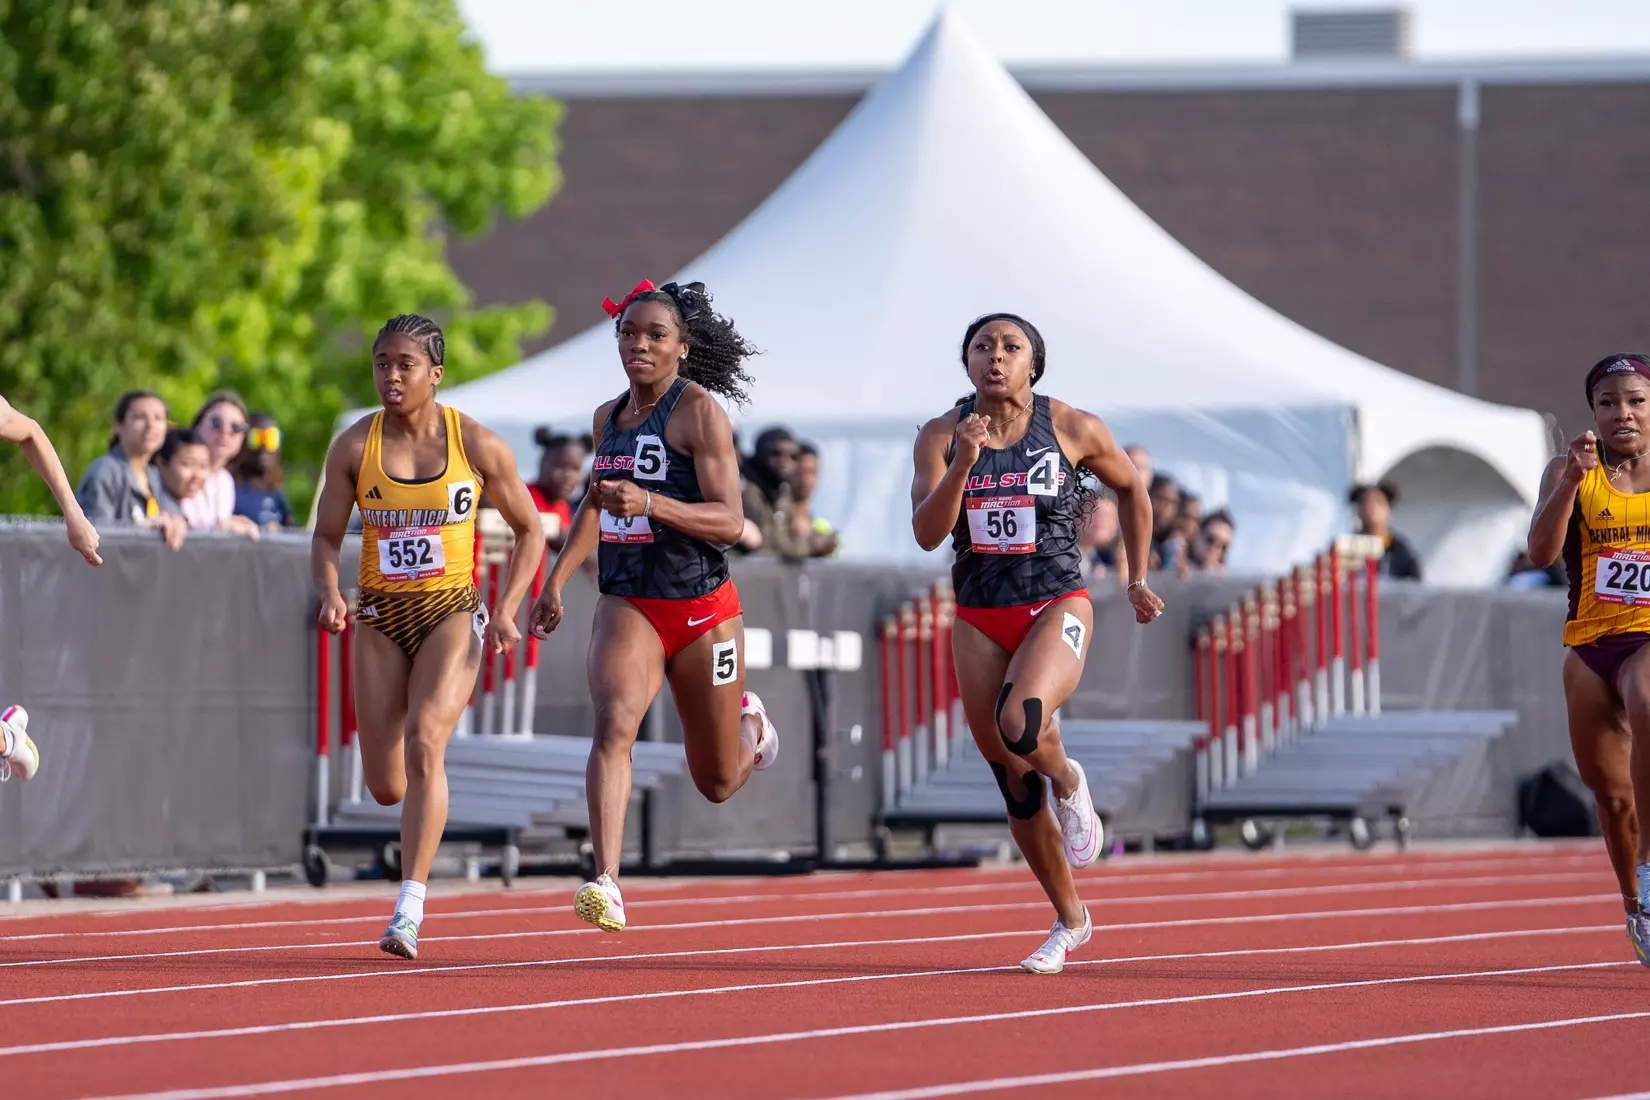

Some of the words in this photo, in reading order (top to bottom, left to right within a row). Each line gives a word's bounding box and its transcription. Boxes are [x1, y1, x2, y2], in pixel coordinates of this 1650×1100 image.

[637, 443, 661, 475] 5
[1000, 472, 1066, 487] STE
[1029, 460, 1055, 490] 4
[454, 487, 472, 515] 6
[987, 510, 1018, 539] 56
[1589, 526, 1632, 544] CENTRAL
[388, 538, 434, 568] 552
[1611, 552, 1650, 561] MACTIO
[1606, 560, 1650, 593] 220
[716, 647, 735, 679] 5
